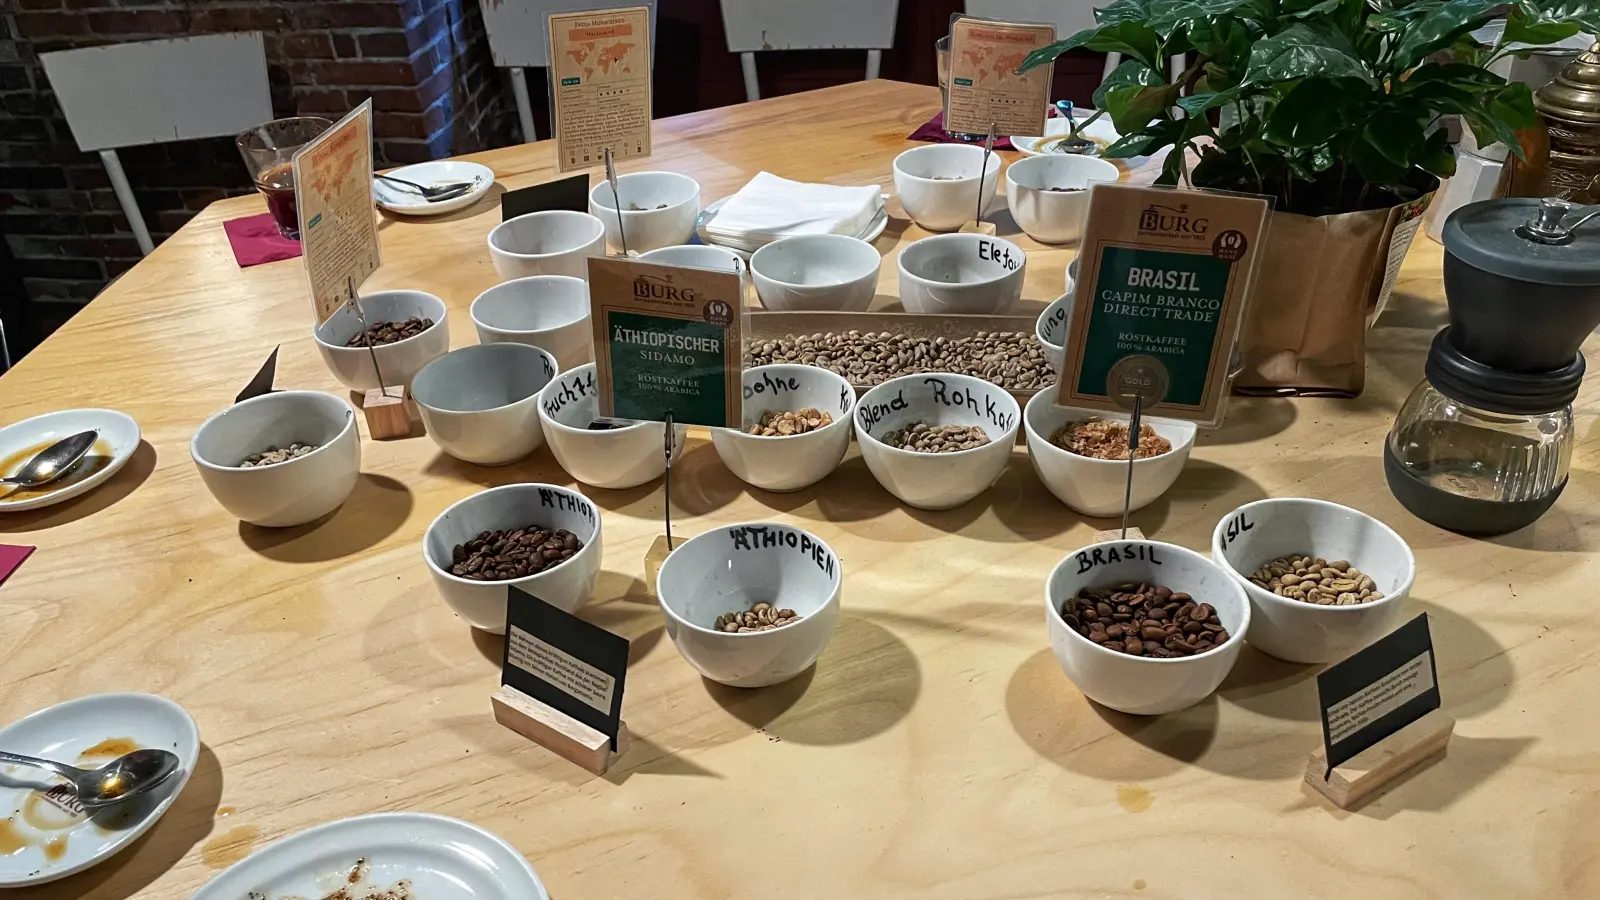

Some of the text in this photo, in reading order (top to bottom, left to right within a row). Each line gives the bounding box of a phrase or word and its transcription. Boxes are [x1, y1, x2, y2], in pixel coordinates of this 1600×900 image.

[1139, 211, 1209, 234] BURG
[1127, 267, 1200, 292] BRASIL
[634, 281, 696, 302] BURG
[1101, 289, 1220, 310] CAPIM BRANCO
[1103, 303, 1214, 322] DIRECT TRADE
[613, 324, 720, 354] ÄTHIOPISCHER
[640, 350, 696, 365] SIDAMO
[1143, 345, 1185, 355] ARABICA
[663, 386, 701, 395] ARABICA
[1125, 377, 1151, 386] GOLD
[860, 389, 908, 434] Blend
[729, 526, 834, 581] ÄTHIOPIEN
[1075, 544, 1162, 575] BRASIL
